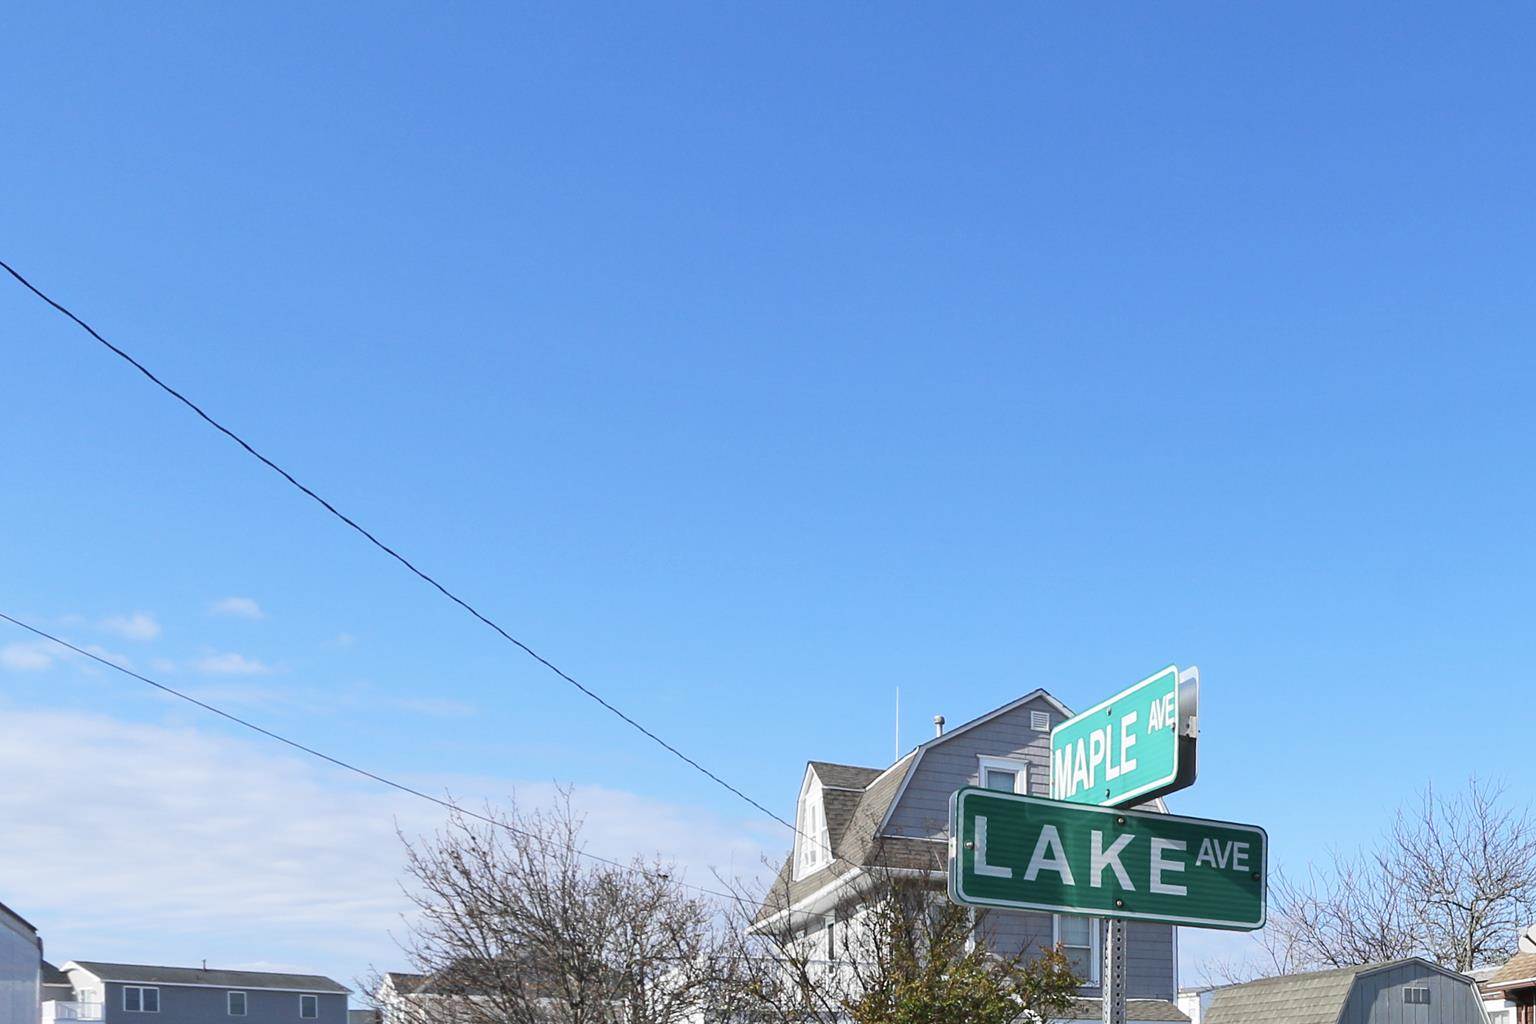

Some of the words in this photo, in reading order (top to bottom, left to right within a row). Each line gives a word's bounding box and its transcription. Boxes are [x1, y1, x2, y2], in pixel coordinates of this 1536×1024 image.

[1054, 710, 1138, 800] MAPLE
[1148, 691, 1175, 735] AVE
[974, 815, 1187, 896] LAKE
[1195, 837, 1250, 871] AVE
